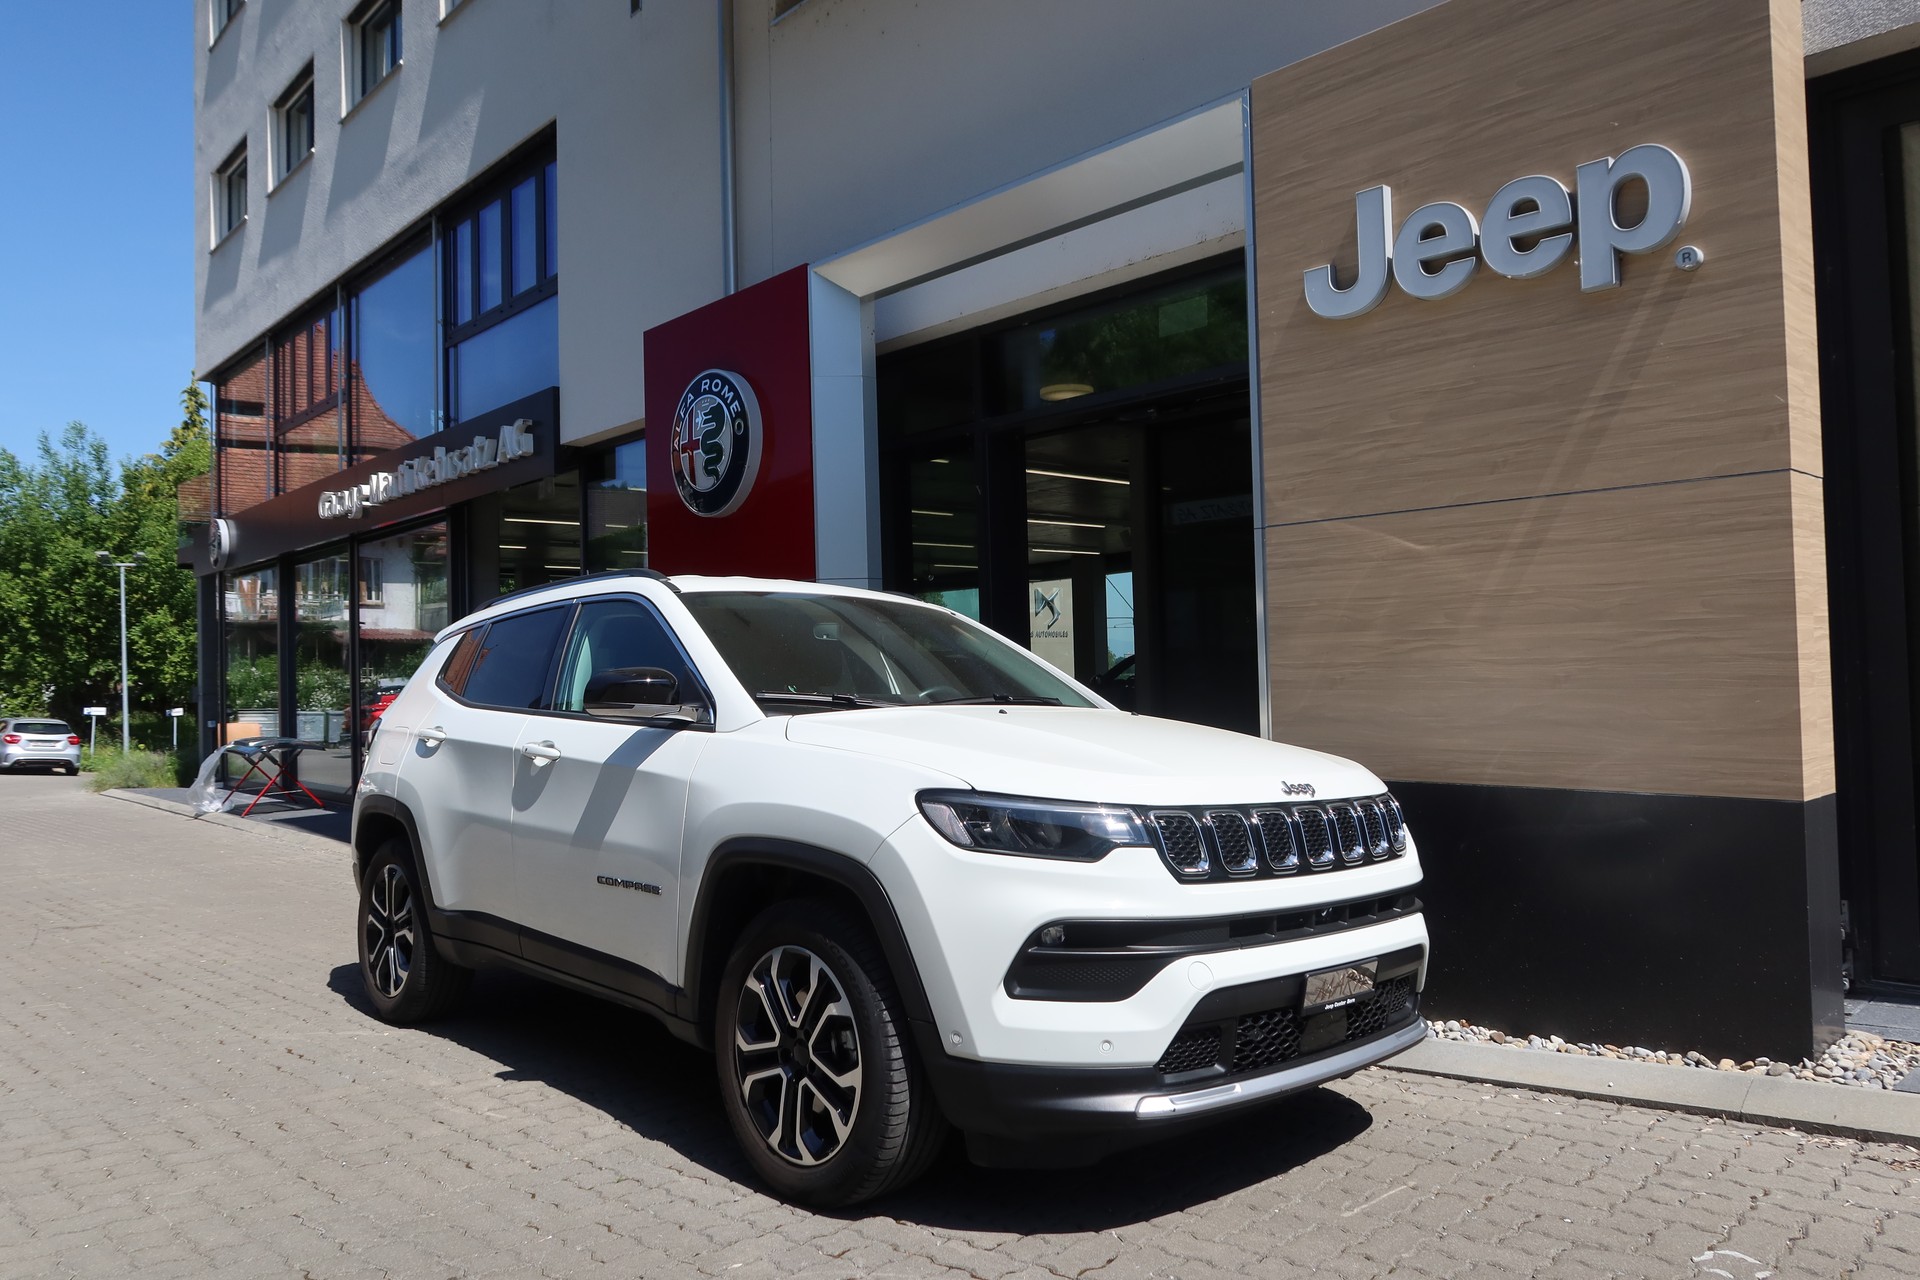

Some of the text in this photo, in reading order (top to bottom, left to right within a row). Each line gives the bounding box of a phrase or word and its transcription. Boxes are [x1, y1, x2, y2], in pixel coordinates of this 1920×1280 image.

[1303, 143, 1692, 319] Jeep
[674, 379, 744, 450] ALFA ROMEO
[497, 418, 534, 464] AG
[1281, 780, 1316, 798] Jeep
[596, 875, 662, 896] COMPASS
